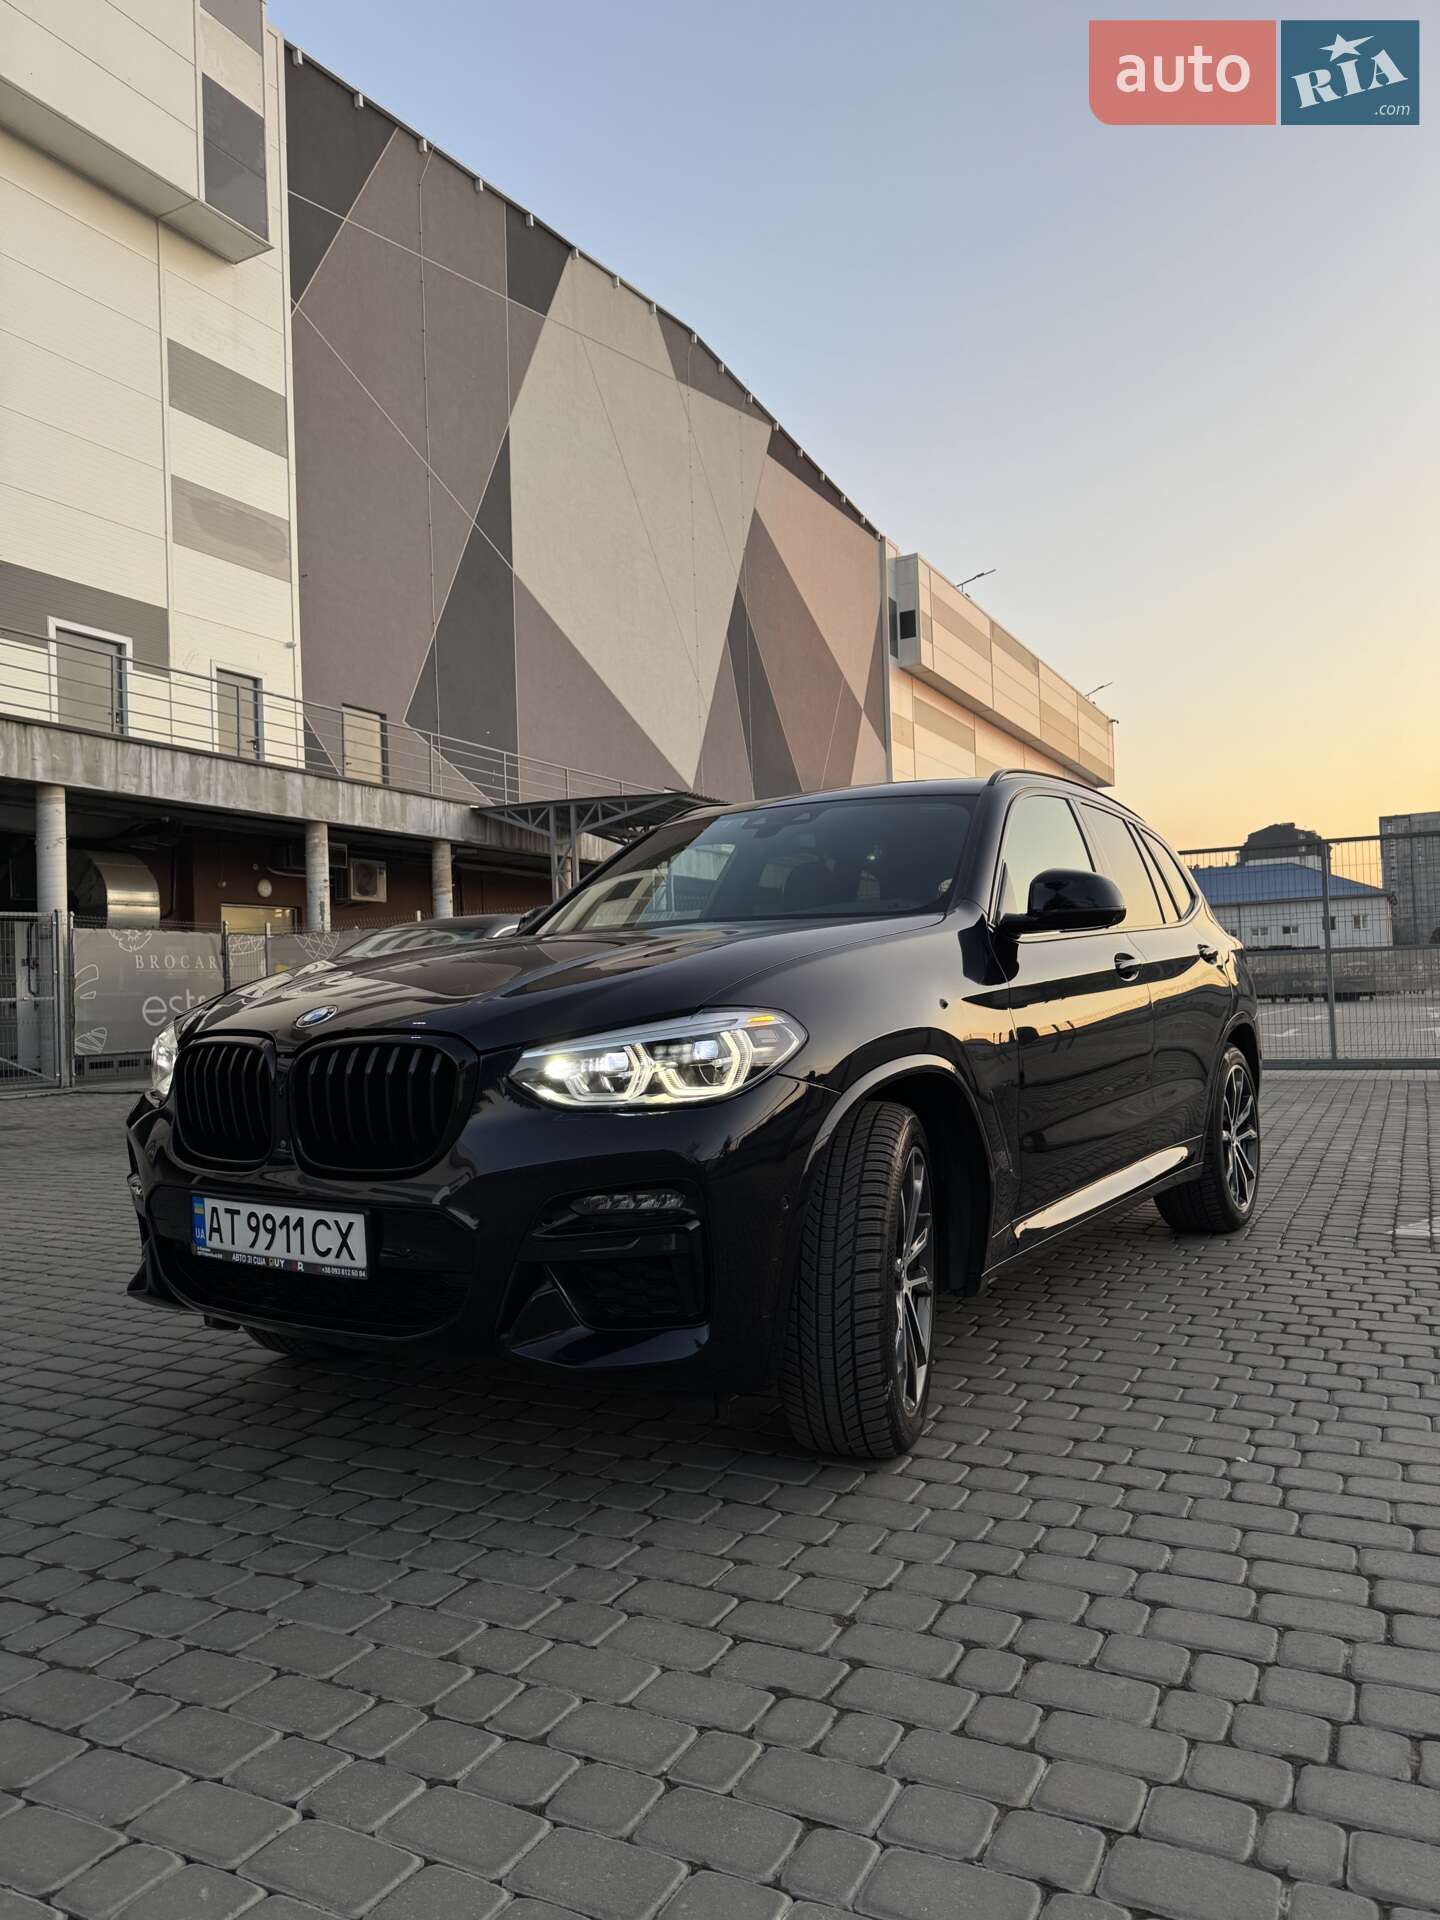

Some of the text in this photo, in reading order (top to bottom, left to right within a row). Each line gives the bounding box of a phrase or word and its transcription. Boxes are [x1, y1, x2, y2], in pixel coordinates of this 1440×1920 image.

[195, 1227, 206, 1239] UA
[208, 1206, 356, 1261] AT 9911 CX
